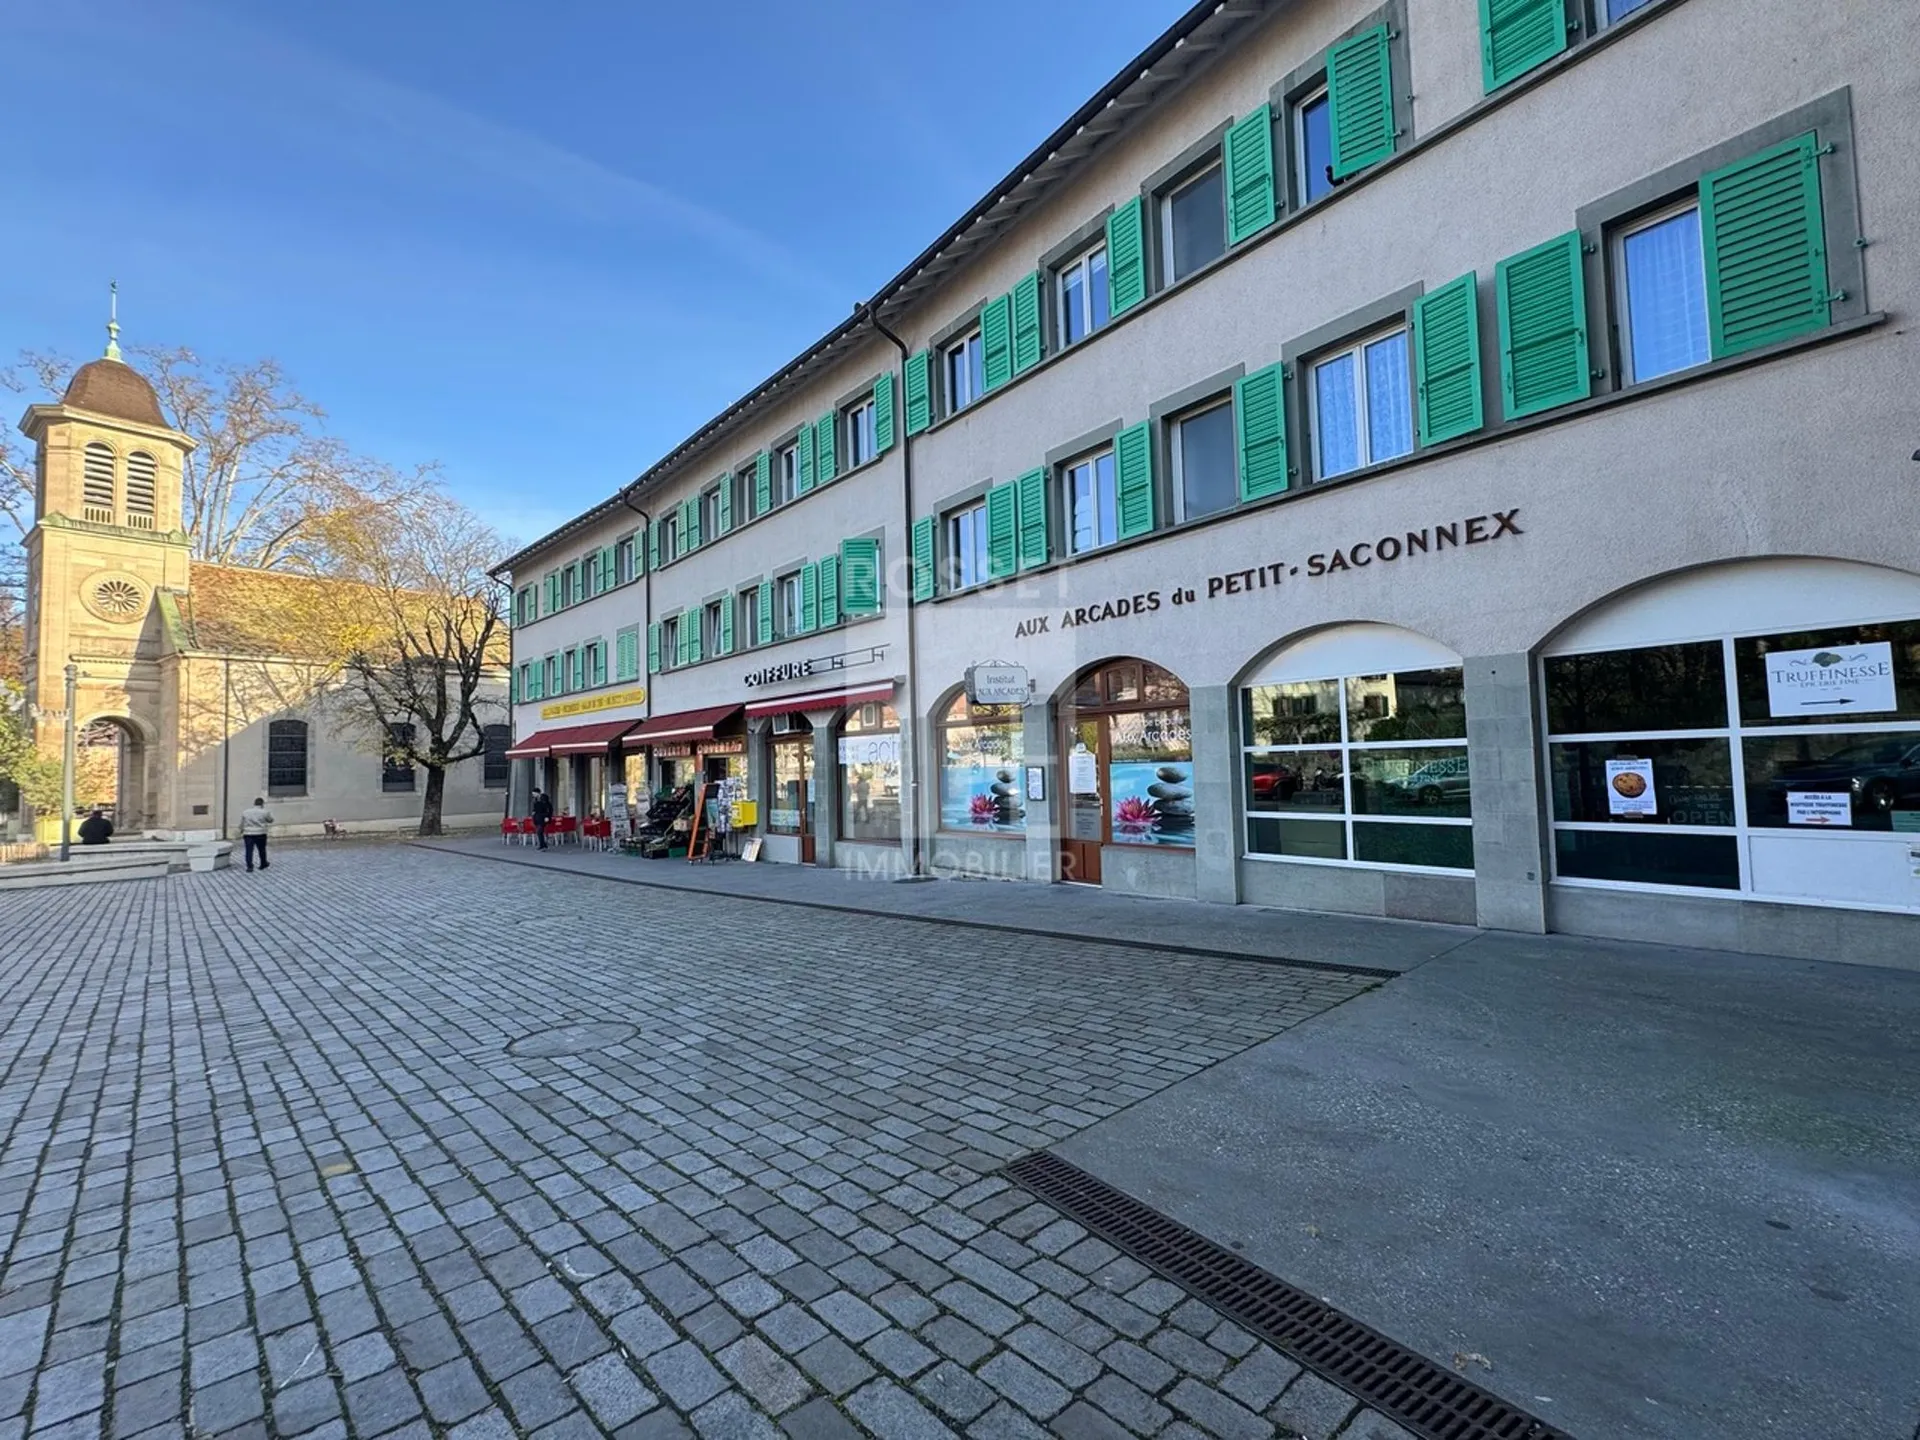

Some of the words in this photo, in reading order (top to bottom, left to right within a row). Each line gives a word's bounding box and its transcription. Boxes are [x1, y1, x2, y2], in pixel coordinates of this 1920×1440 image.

[1015, 616, 1050, 638] AUX
[1061, 591, 1161, 629] ARCADES
[1171, 587, 1196, 605] du
[744, 659, 813, 687] COIFFURE
[986, 674, 1016, 685] Institut
[1772, 661, 1890, 683] TRUFFINESSE
[1141, 724, 1192, 742] Arcades
[1672, 810, 1734, 825] OPEN
